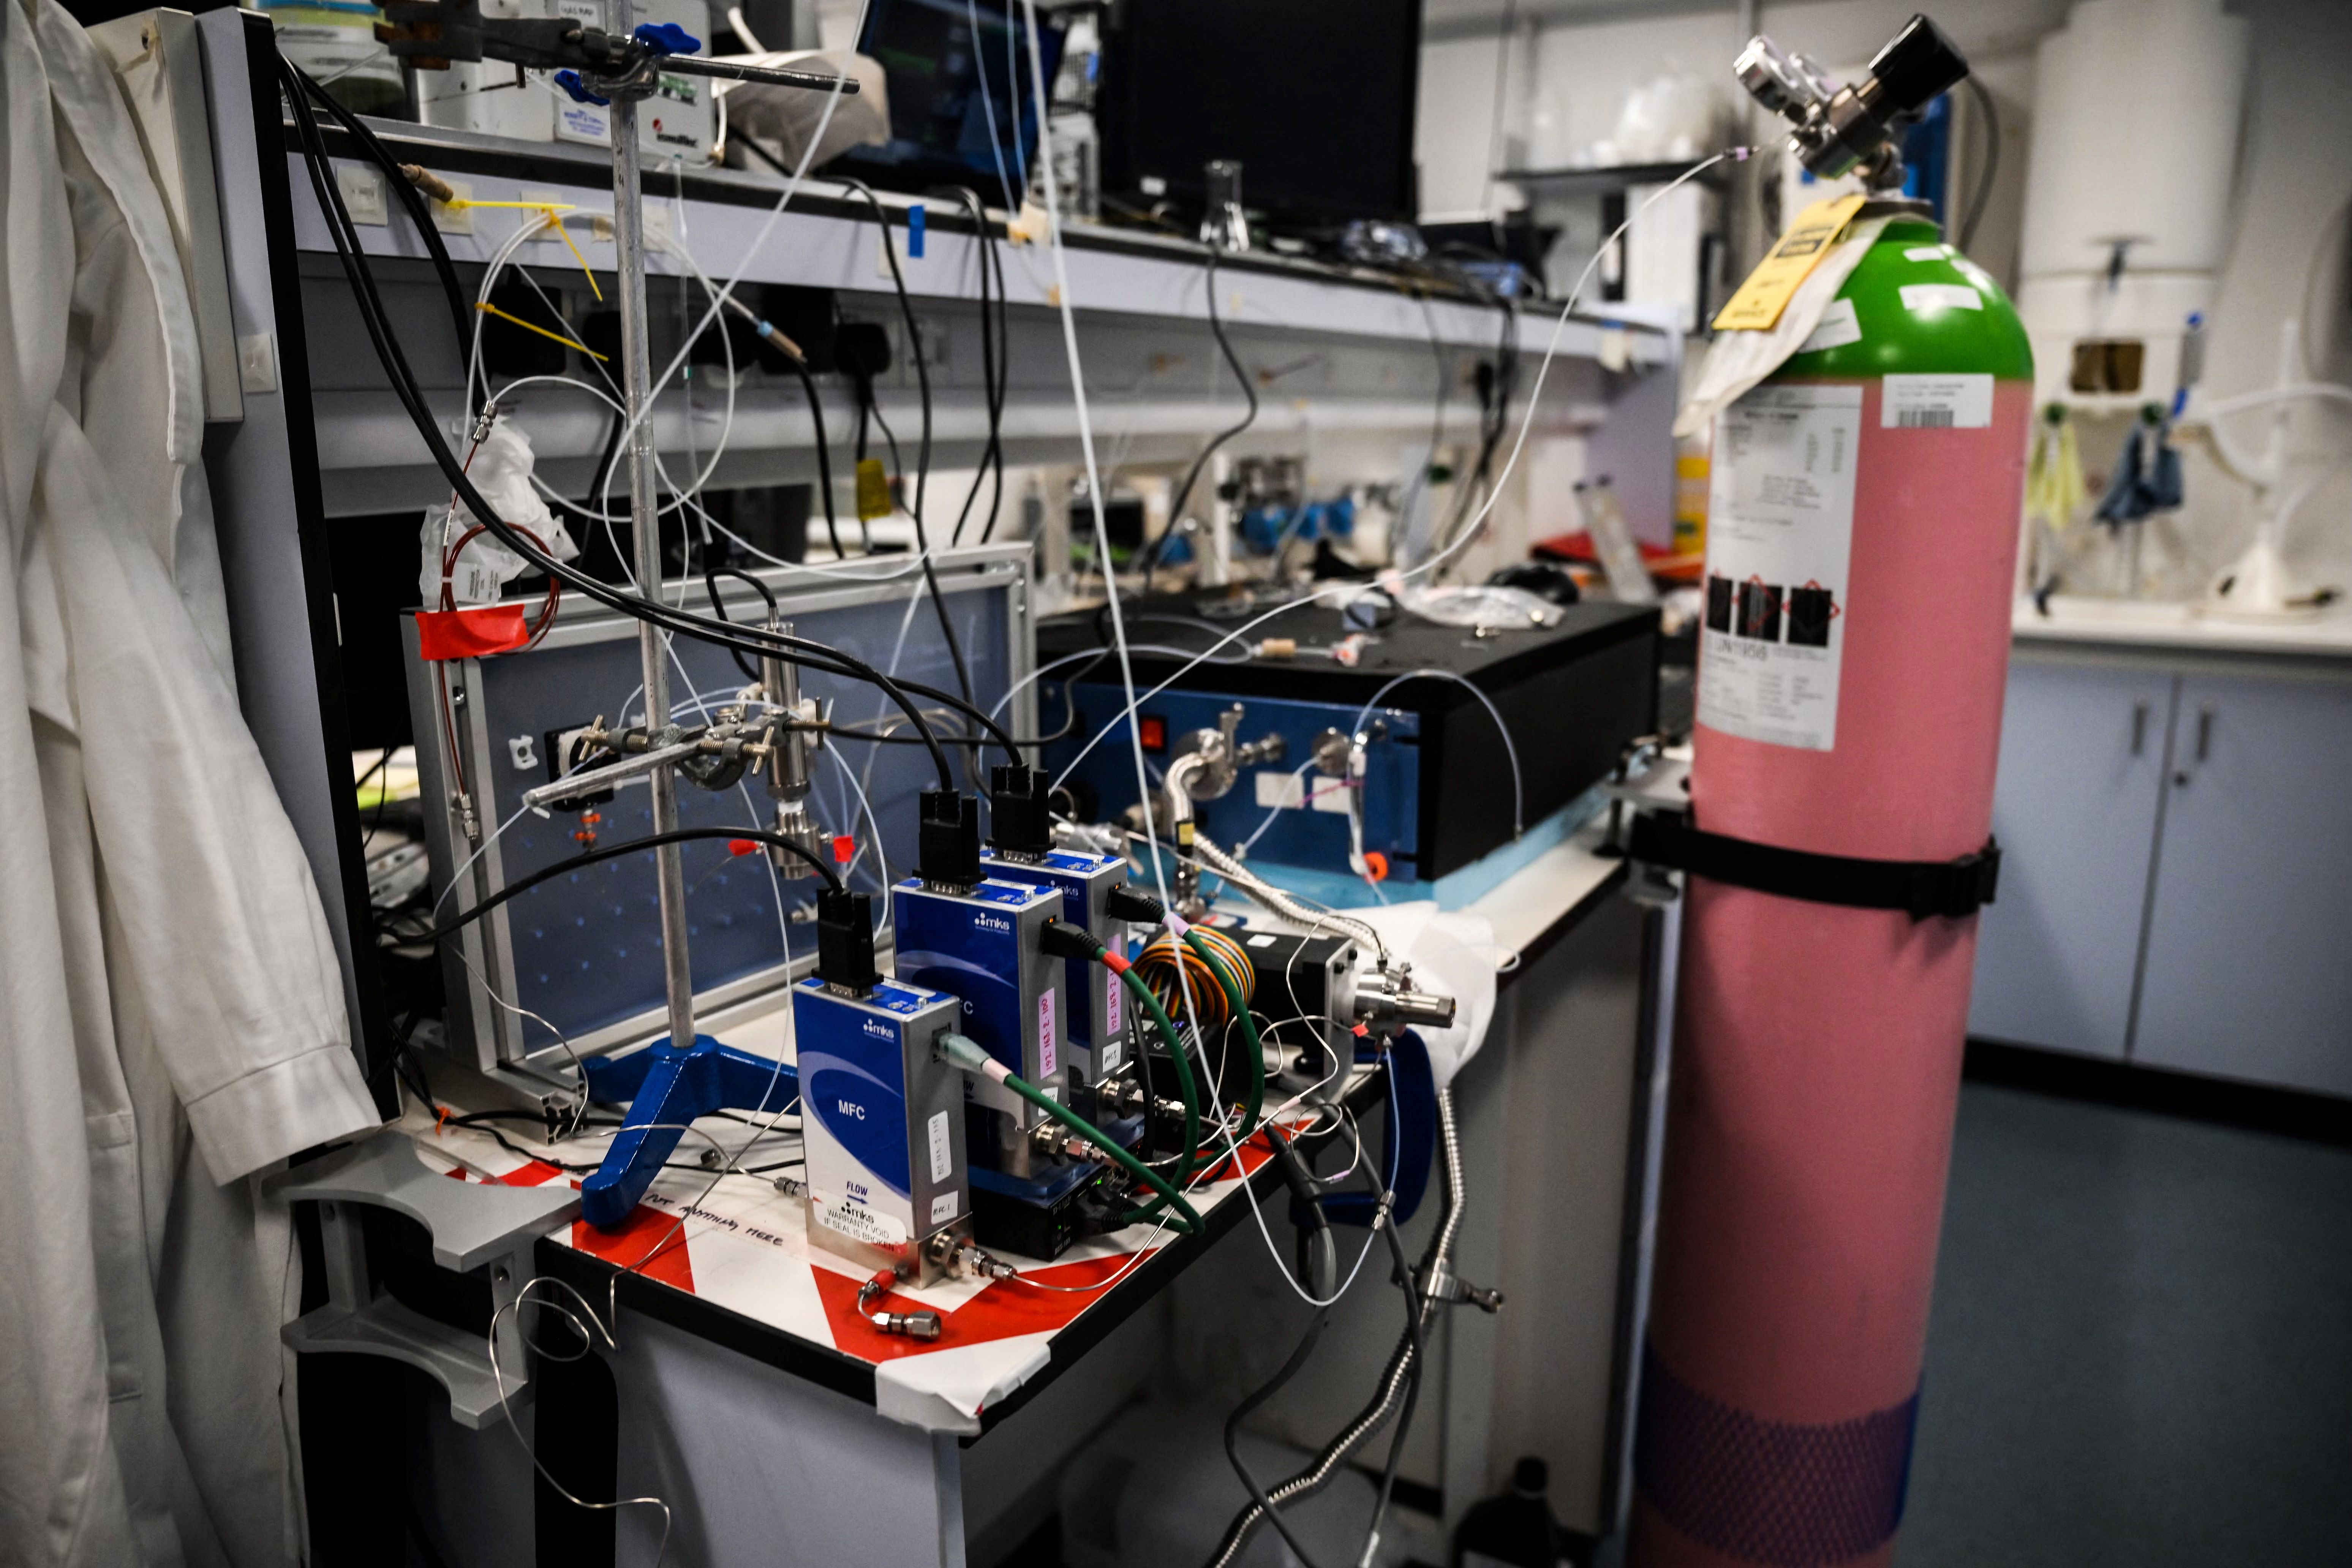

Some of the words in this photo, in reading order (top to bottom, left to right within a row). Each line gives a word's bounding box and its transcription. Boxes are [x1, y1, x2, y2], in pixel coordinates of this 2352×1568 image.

[986, 917, 1010, 931] mks
[838, 1099, 865, 1121] MFC
[846, 1181, 868, 1196] FLOW
[827, 1207, 869, 1231] WARRANTY
[870, 1227, 890, 1240] VOID
[852, 1208, 874, 1225] mks
[745, 1227, 784, 1246] HERE
[824, 1216, 831, 1225] IF
[832, 1219, 851, 1234] SEAL
[853, 1228, 861, 1238] IS
[863, 1232, 895, 1252] BROKEN
